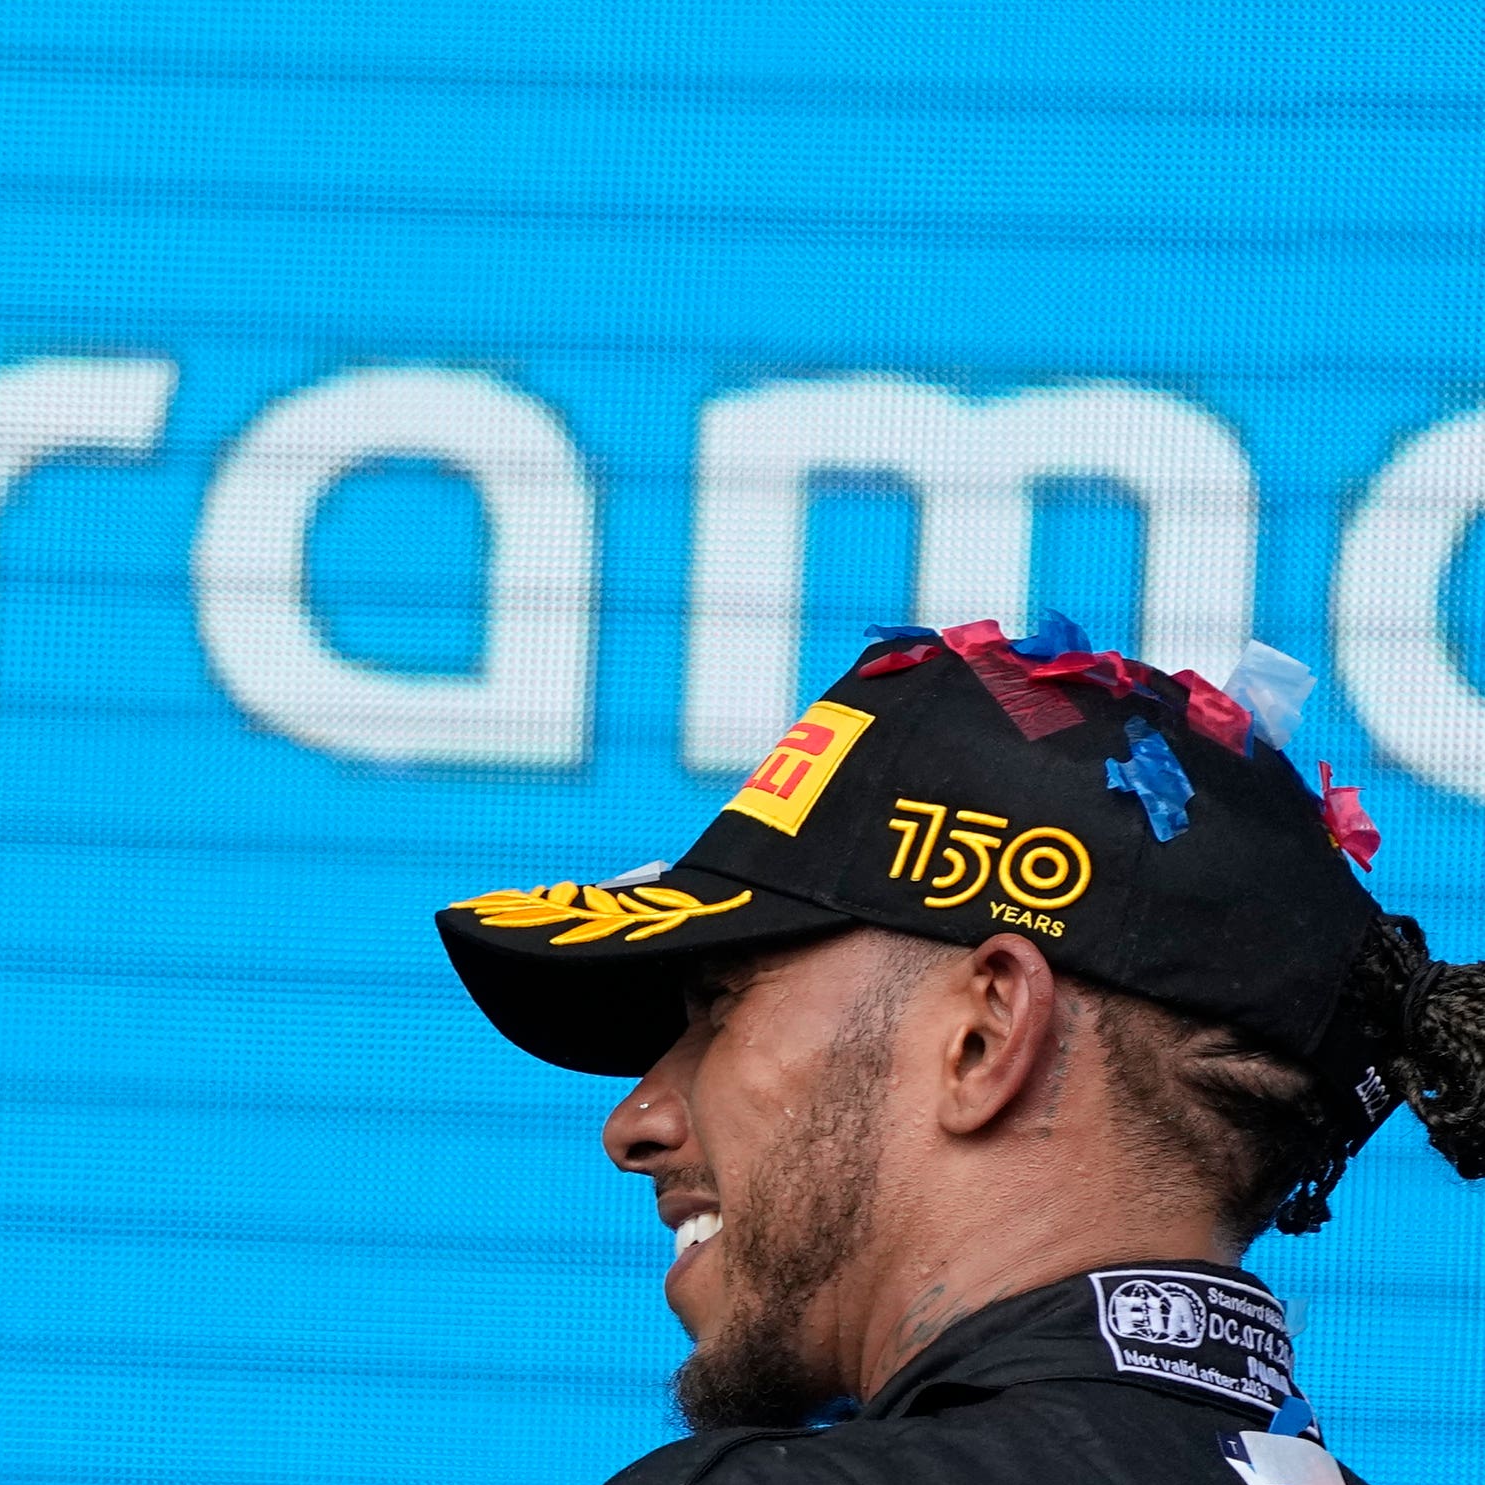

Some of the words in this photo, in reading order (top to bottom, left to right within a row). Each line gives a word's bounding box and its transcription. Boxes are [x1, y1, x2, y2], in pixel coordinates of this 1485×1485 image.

[888, 798, 1092, 910] 150
[989, 900, 1066, 938] YEARS
[1123, 1349, 1157, 1368] Not
[1162, 1355, 1198, 1378] valid
